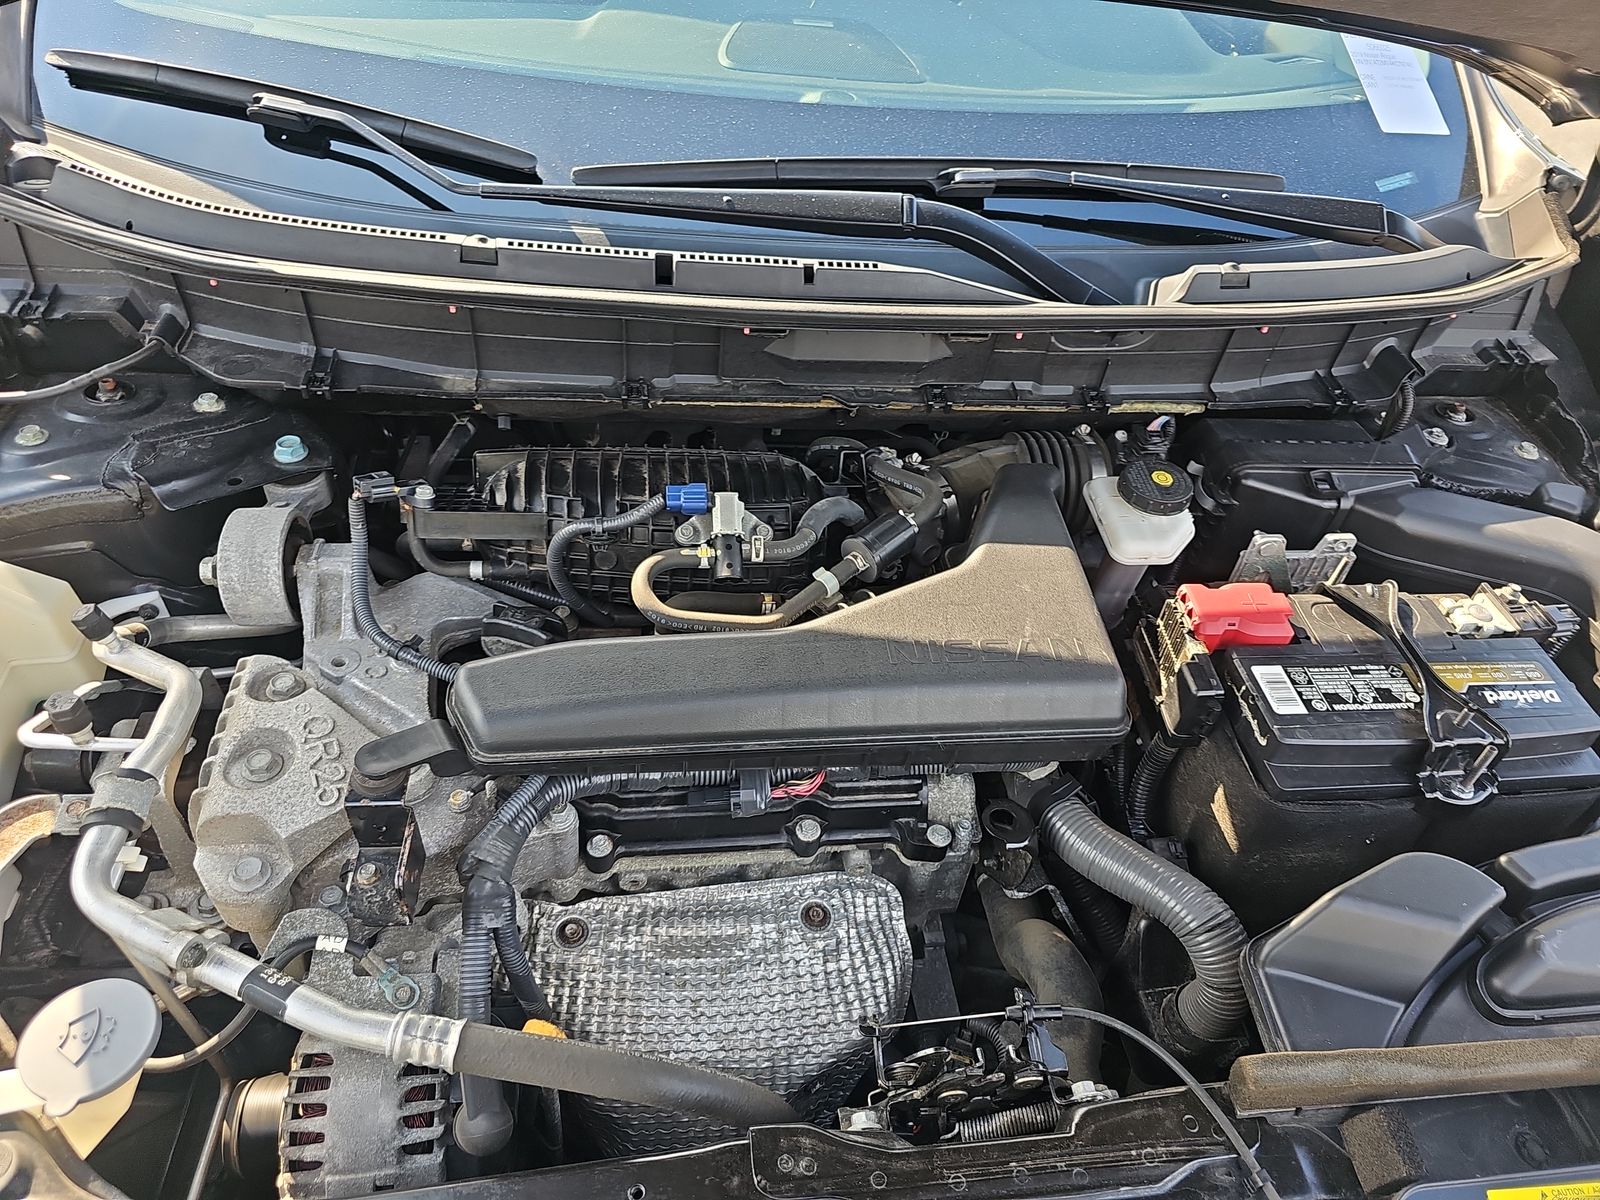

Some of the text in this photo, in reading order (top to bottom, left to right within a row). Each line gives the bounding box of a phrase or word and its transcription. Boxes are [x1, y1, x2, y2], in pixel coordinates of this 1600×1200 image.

[885, 637, 1090, 665] NISSAN
[1481, 688, 1562, 704] DieHard
[303, 715, 349, 807] QR25
[1551, 1187, 1586, 1197] CAUTION
